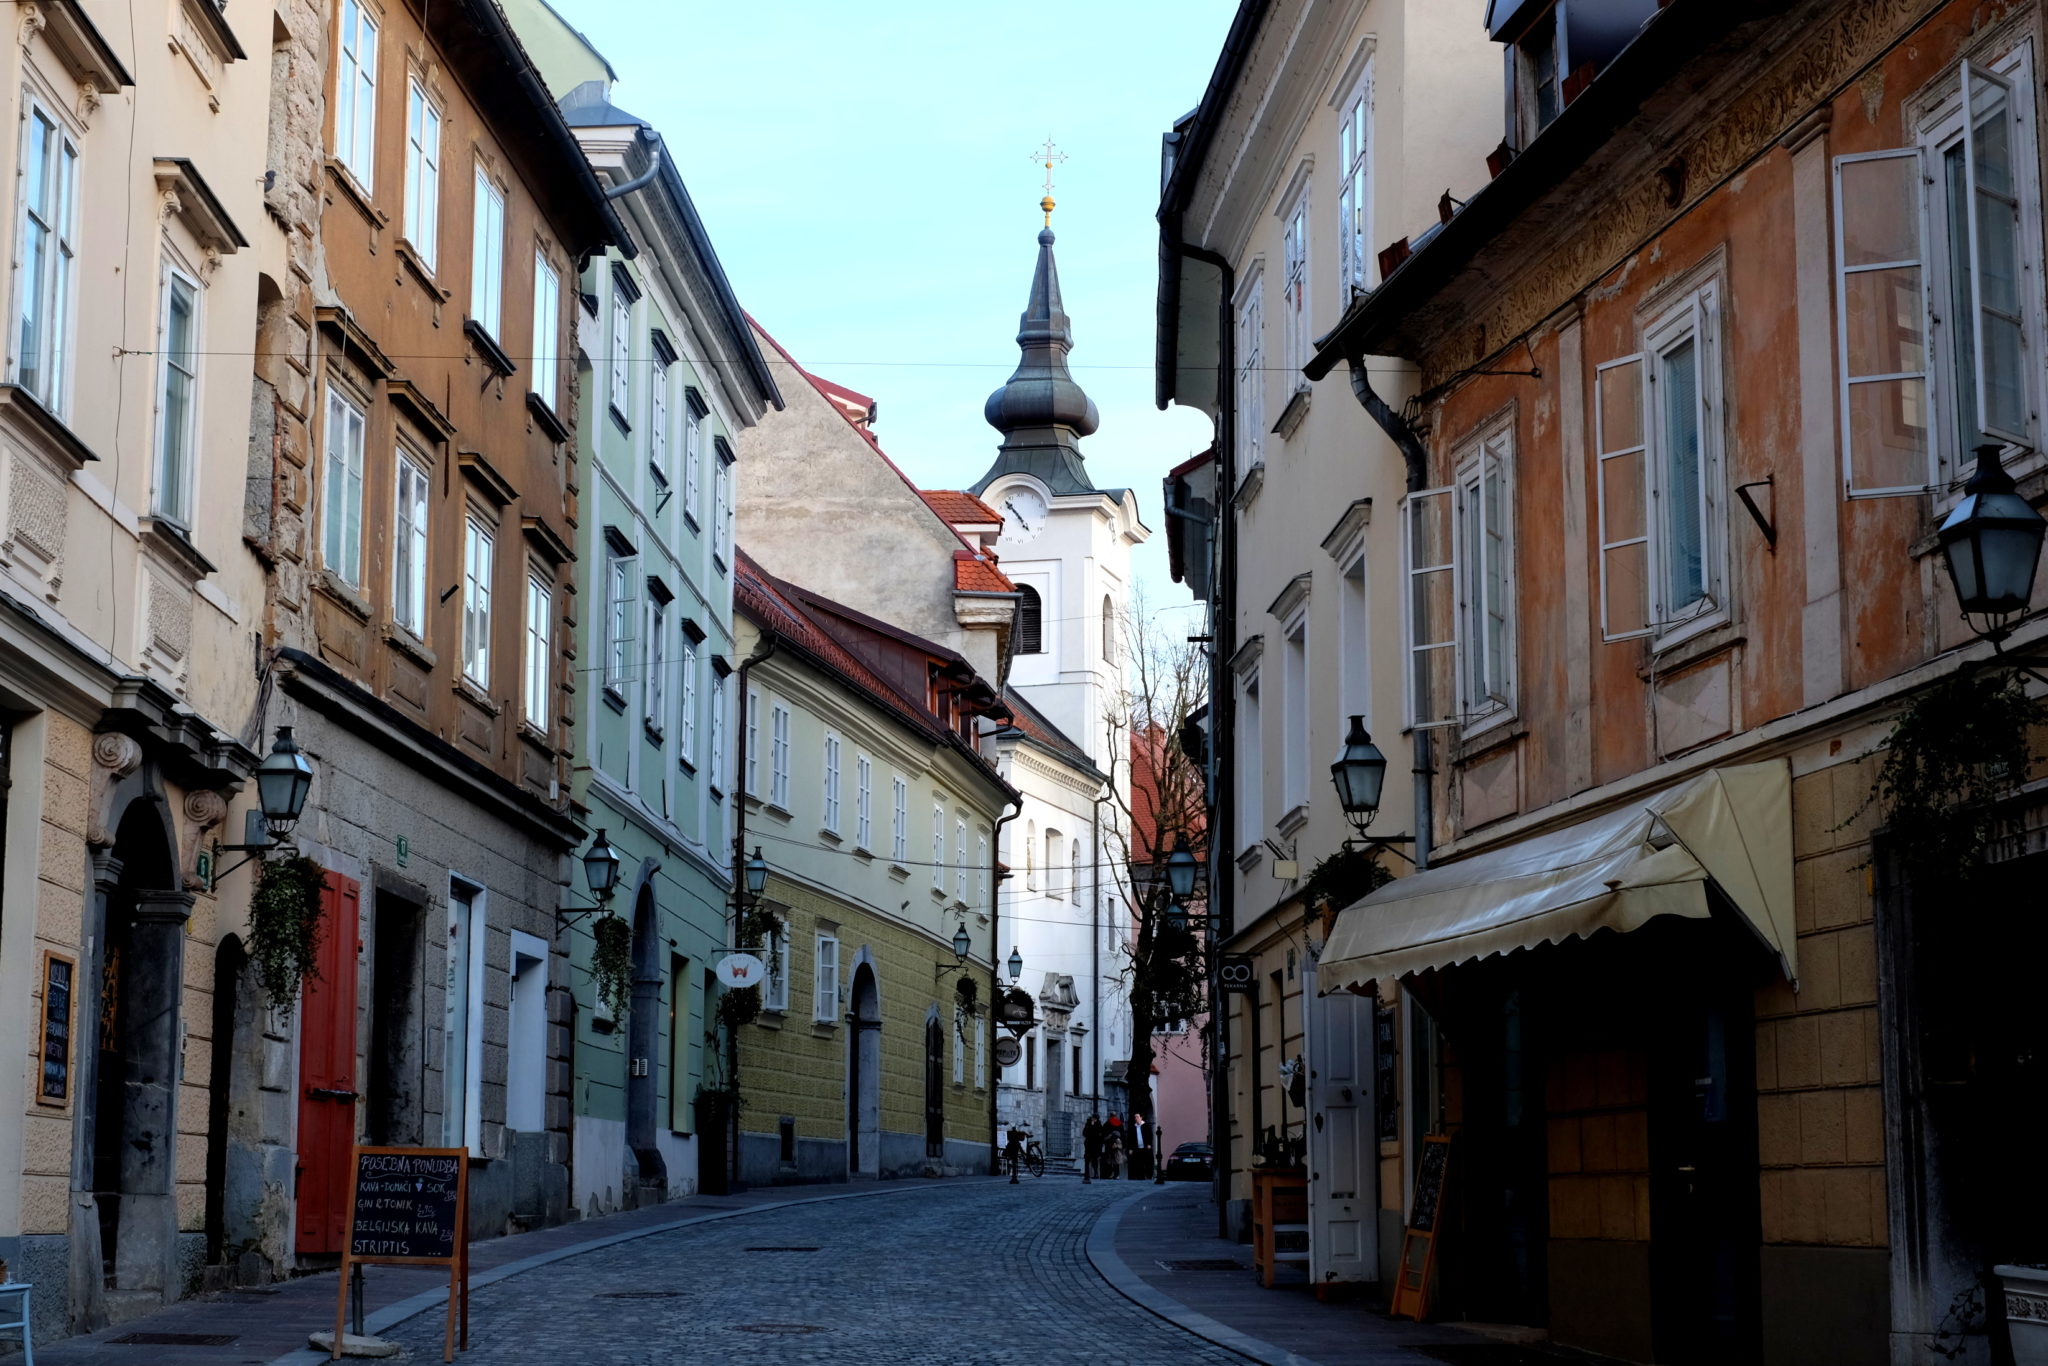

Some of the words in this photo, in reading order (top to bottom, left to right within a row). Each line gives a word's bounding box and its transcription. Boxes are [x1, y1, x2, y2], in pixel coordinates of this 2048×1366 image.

[361, 1155, 410, 1172] POSEBNA
[413, 1158, 459, 1173] PONUDBA
[427, 1183, 446, 1193] SOK
[358, 1199, 373, 1211] GIN
[355, 1220, 410, 1234] BELGIJSKA
[416, 1221, 438, 1234] KAVA
[354, 1240, 409, 1254] STRIPTIS
